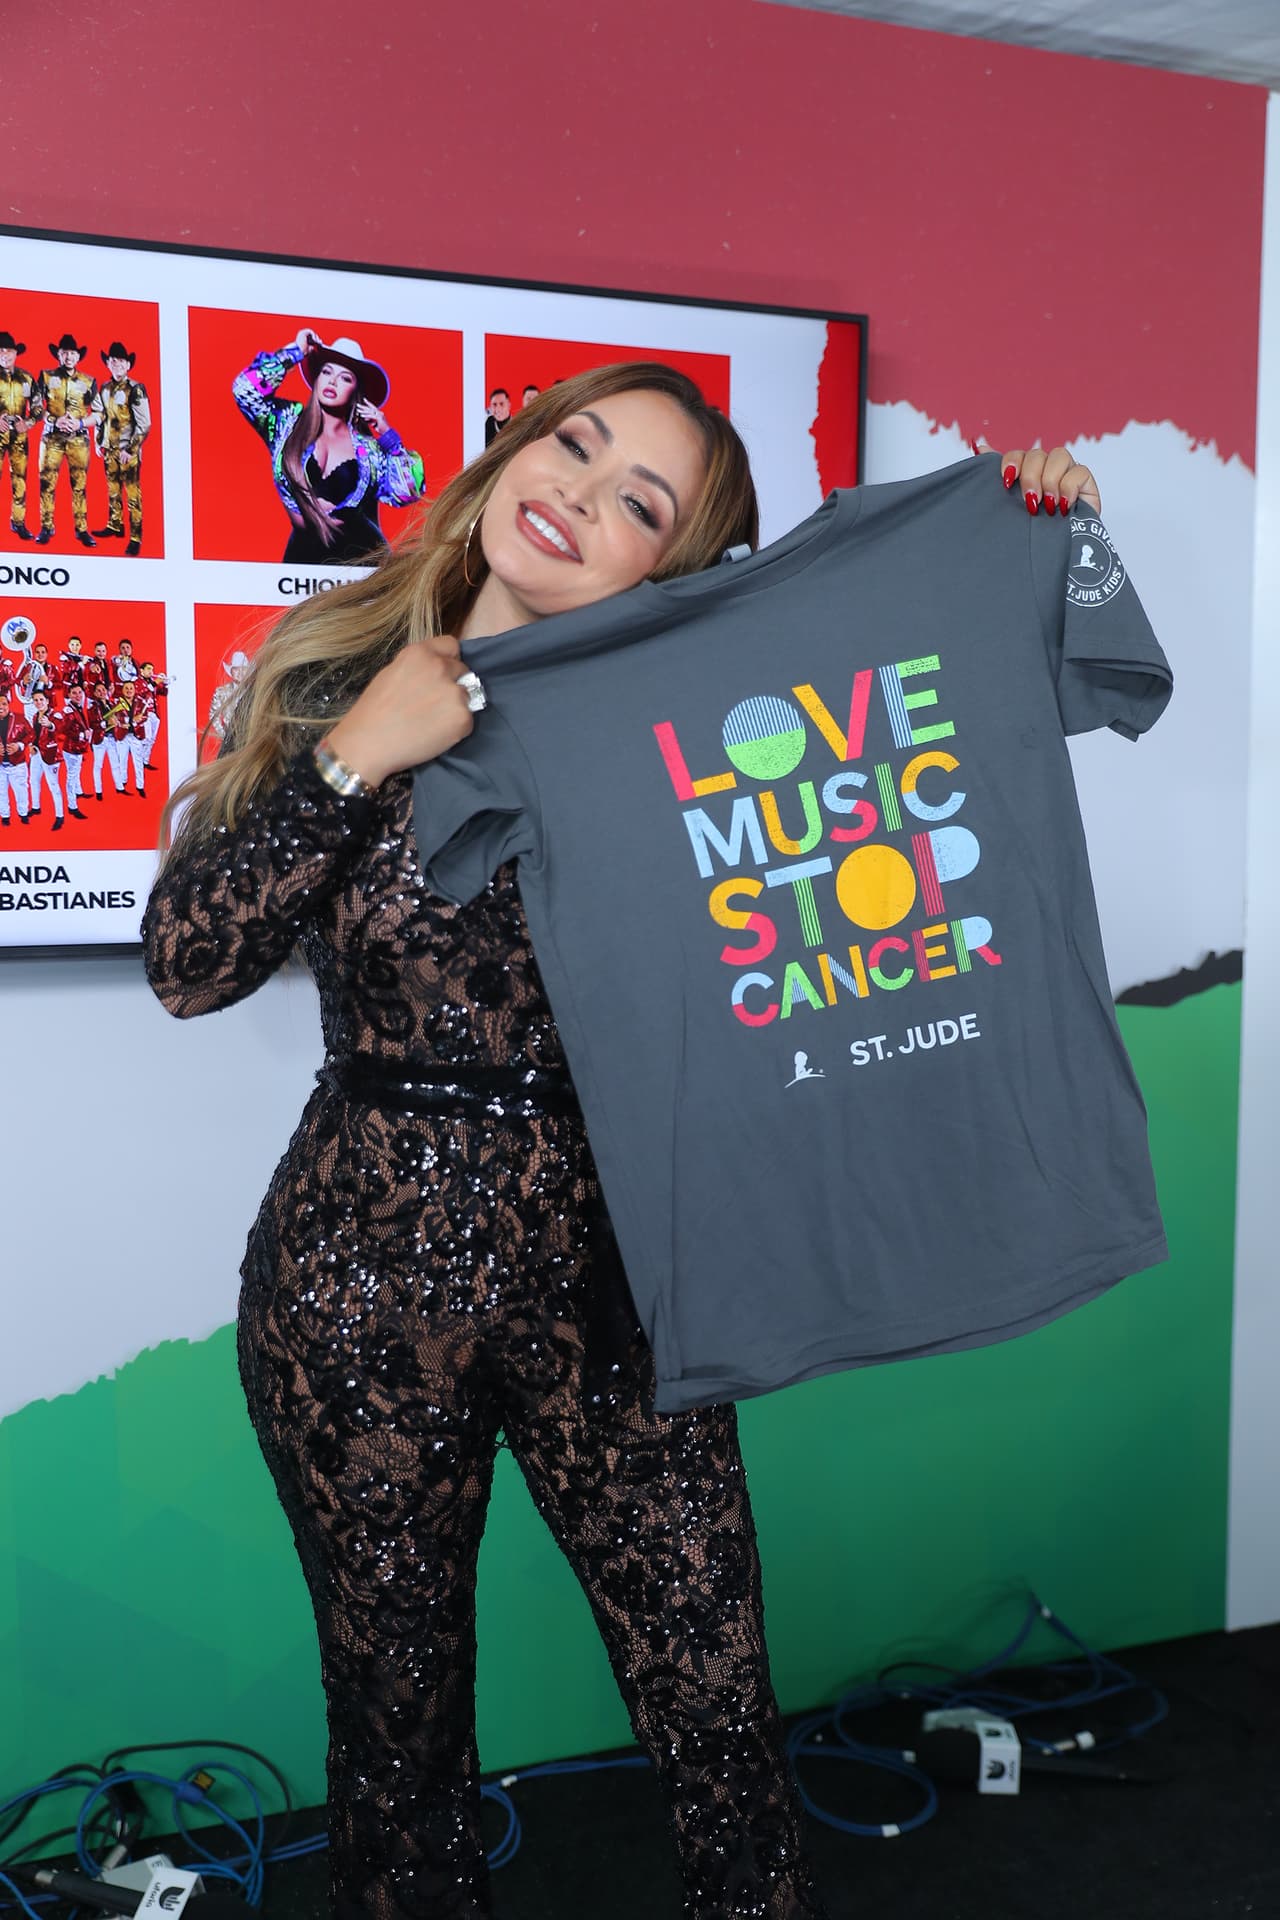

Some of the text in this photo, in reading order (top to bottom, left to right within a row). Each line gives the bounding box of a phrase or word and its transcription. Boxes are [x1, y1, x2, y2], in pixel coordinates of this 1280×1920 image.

[1102, 570, 1121, 596] KIDS
[653, 654, 956, 801] LOVE
[682, 751, 966, 878] MUSIC
[708, 825, 980, 966] STOP
[731, 916, 1002, 1027] CANCER
[850, 1013, 981, 1066] ST. JUDE
